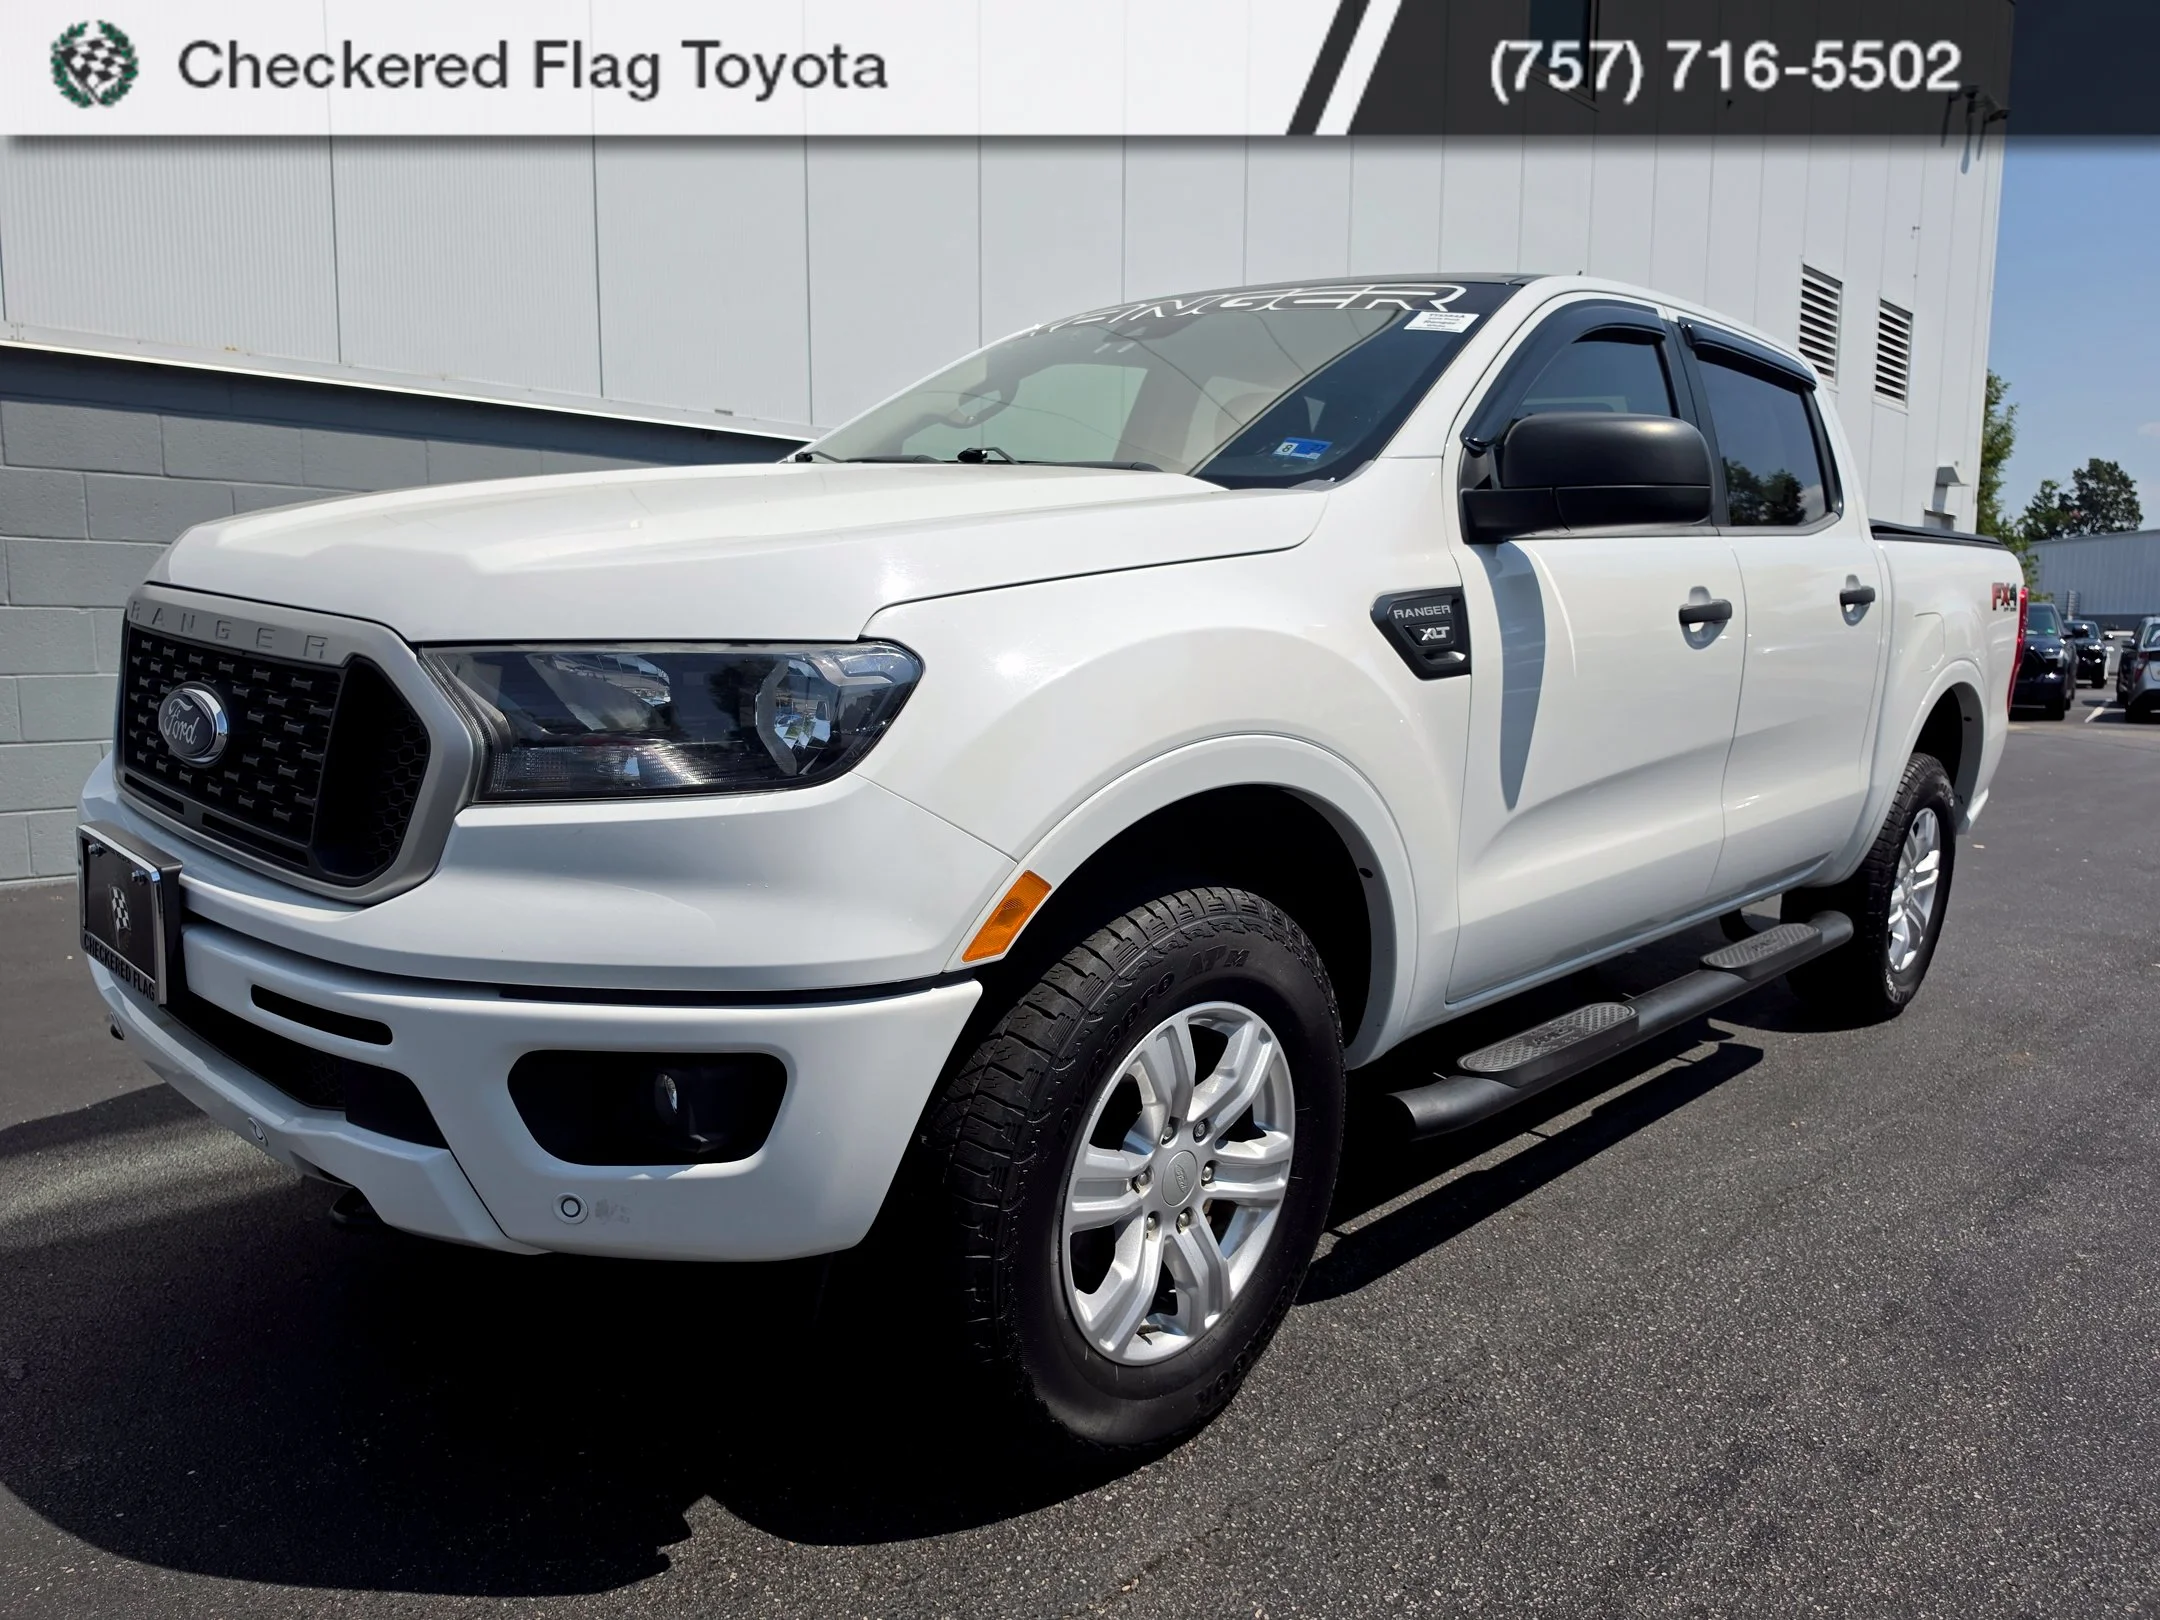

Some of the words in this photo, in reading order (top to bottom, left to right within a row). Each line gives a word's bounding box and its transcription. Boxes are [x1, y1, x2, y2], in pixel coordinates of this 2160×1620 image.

[1393, 605, 1451, 619] RANGER
[1991, 582, 2017, 611] FX4
[130, 600, 329, 660] RANGER
[1420, 626, 1450, 641] XLT
[163, 697, 201, 745] Ford
[84, 934, 131, 982] CHECKERED
[132, 970, 155, 1002] FLAG
